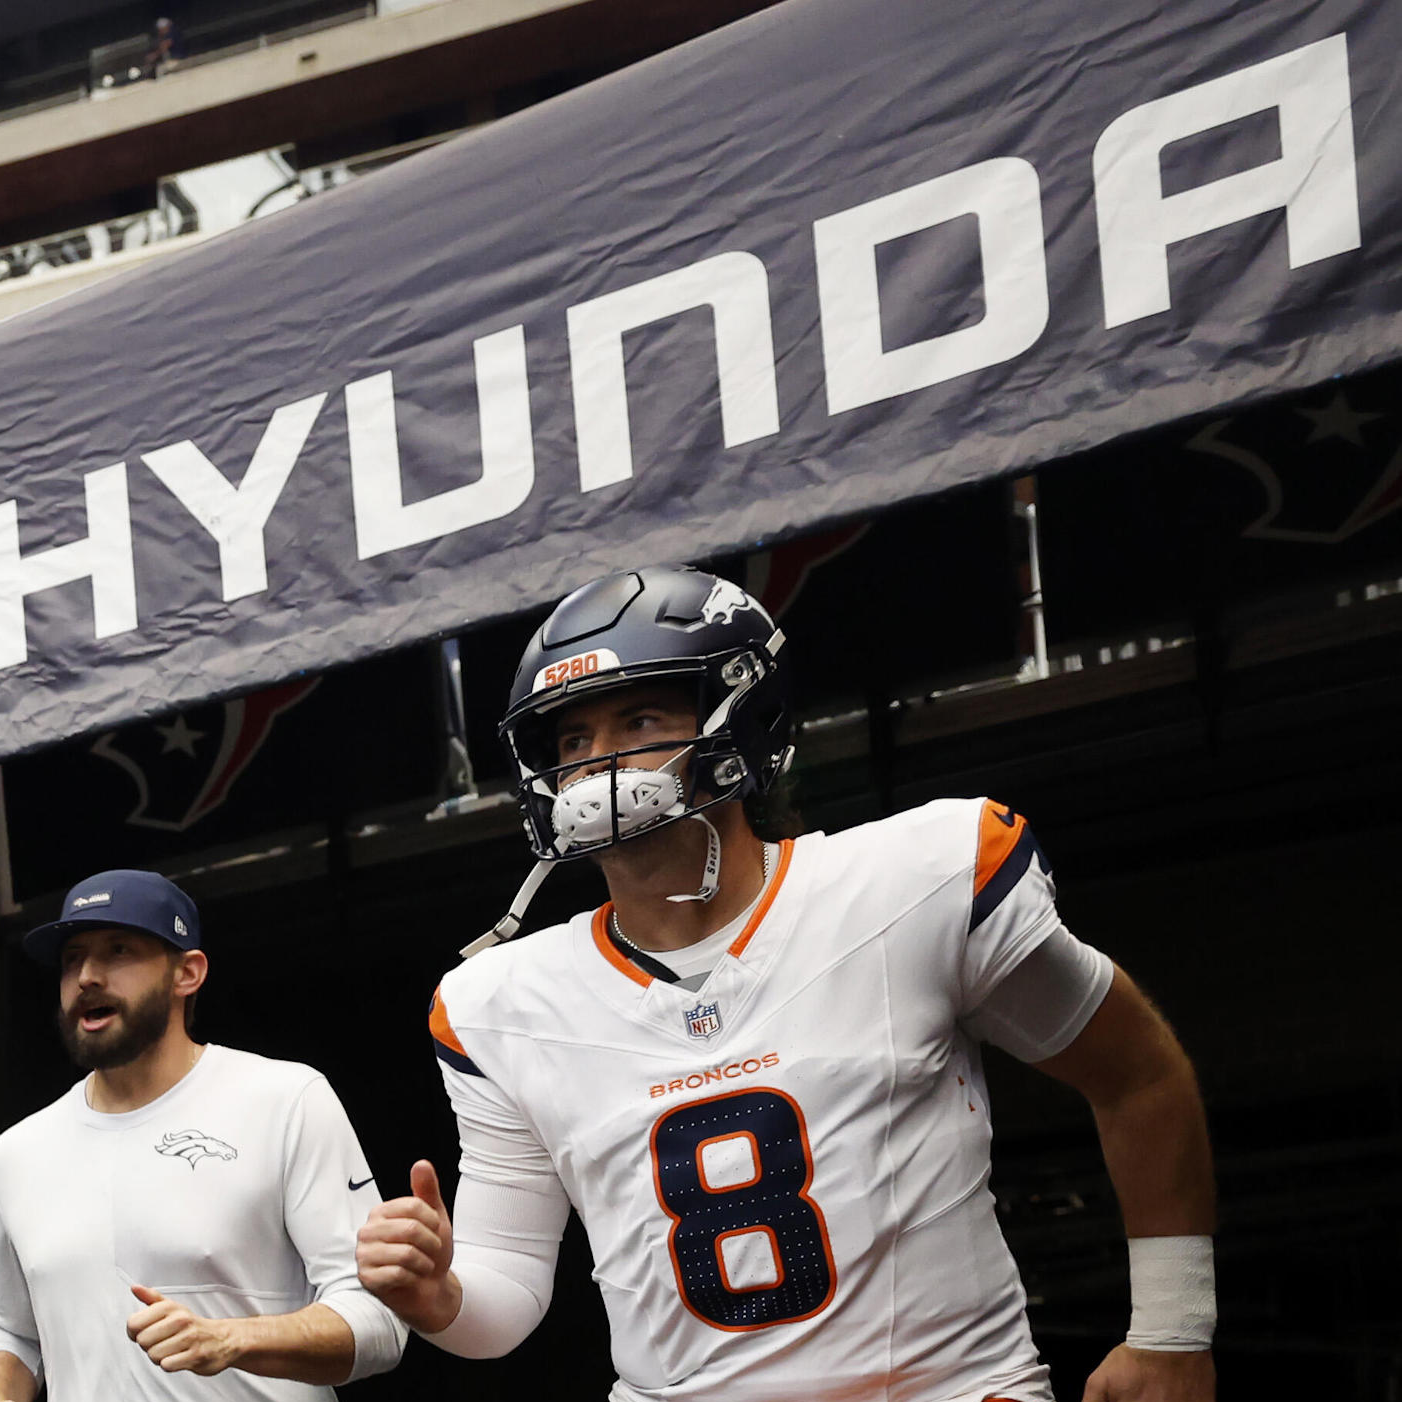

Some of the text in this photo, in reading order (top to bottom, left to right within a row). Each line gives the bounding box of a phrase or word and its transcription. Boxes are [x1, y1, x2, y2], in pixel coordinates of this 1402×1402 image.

[545, 653, 598, 688] 5280
[691, 1017, 717, 1034] NFL
[649, 1052, 780, 1098] BRONCOS
[650, 1086, 838, 1333] 8
